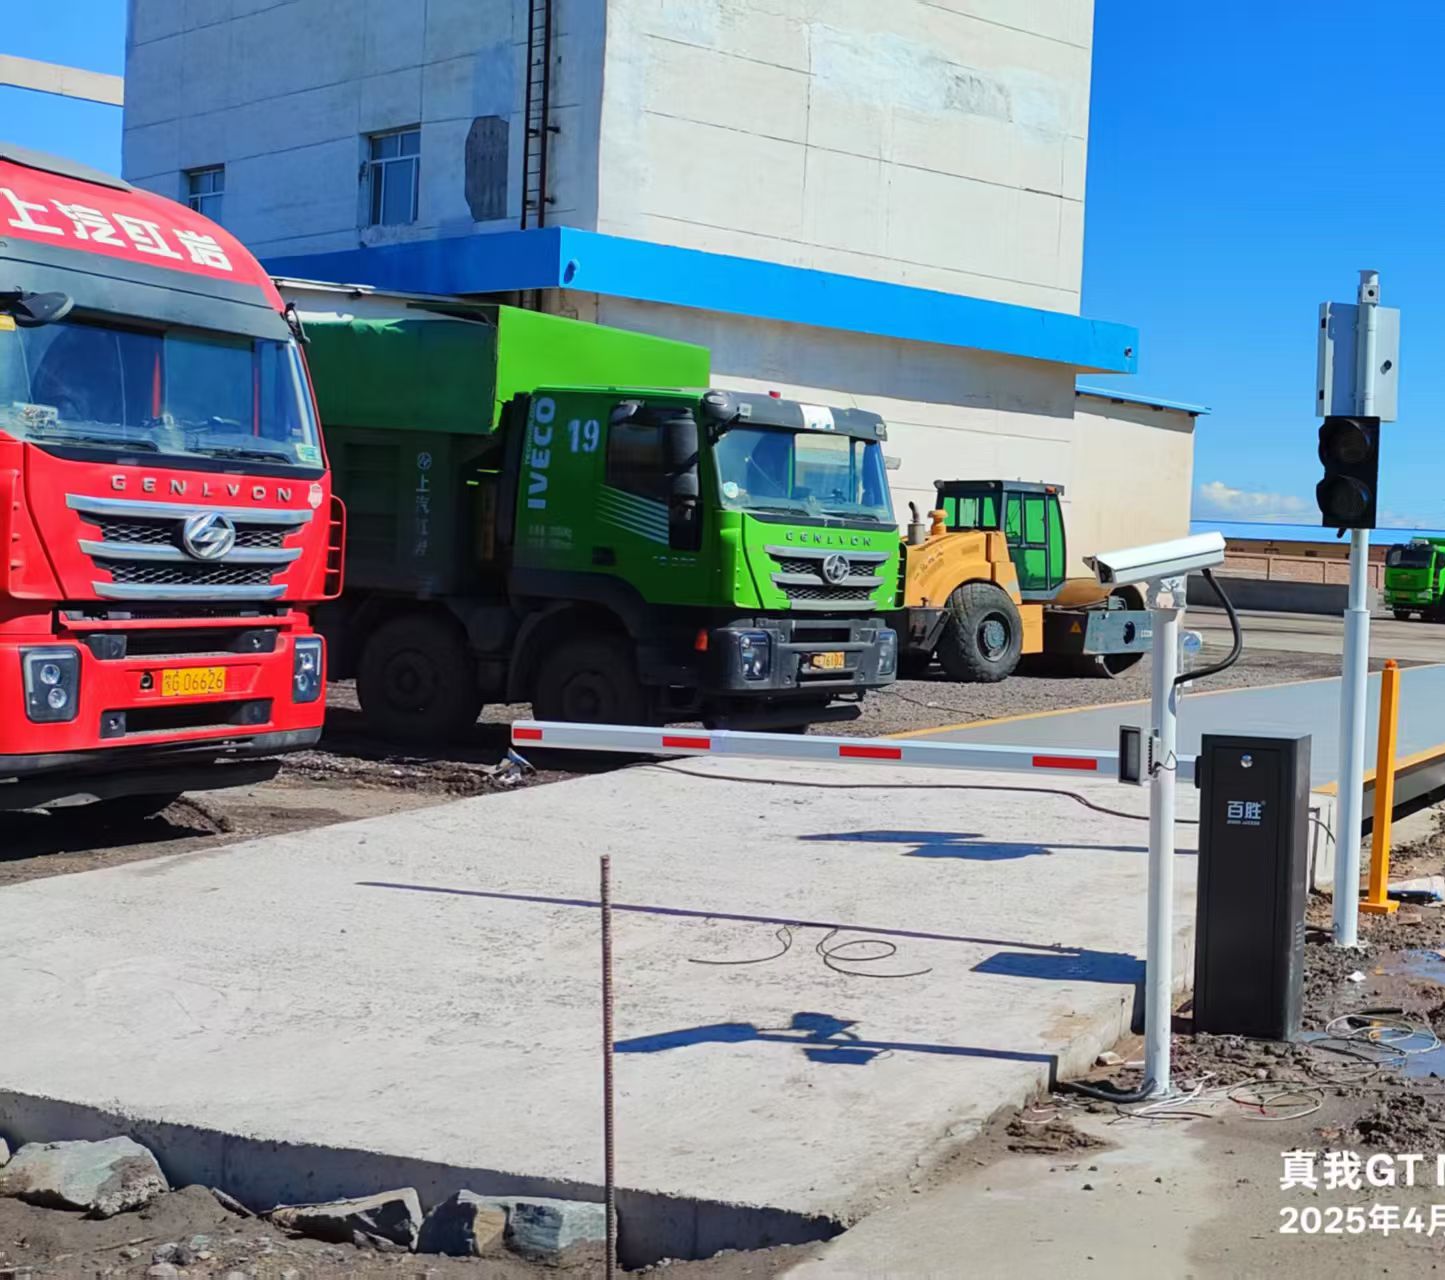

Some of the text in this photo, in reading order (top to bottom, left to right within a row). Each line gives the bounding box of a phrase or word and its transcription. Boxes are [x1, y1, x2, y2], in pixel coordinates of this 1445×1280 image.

[528, 396, 556, 509] IVECO
[568, 418, 601, 453] 19
[1227, 800, 1262, 820] 百胜
